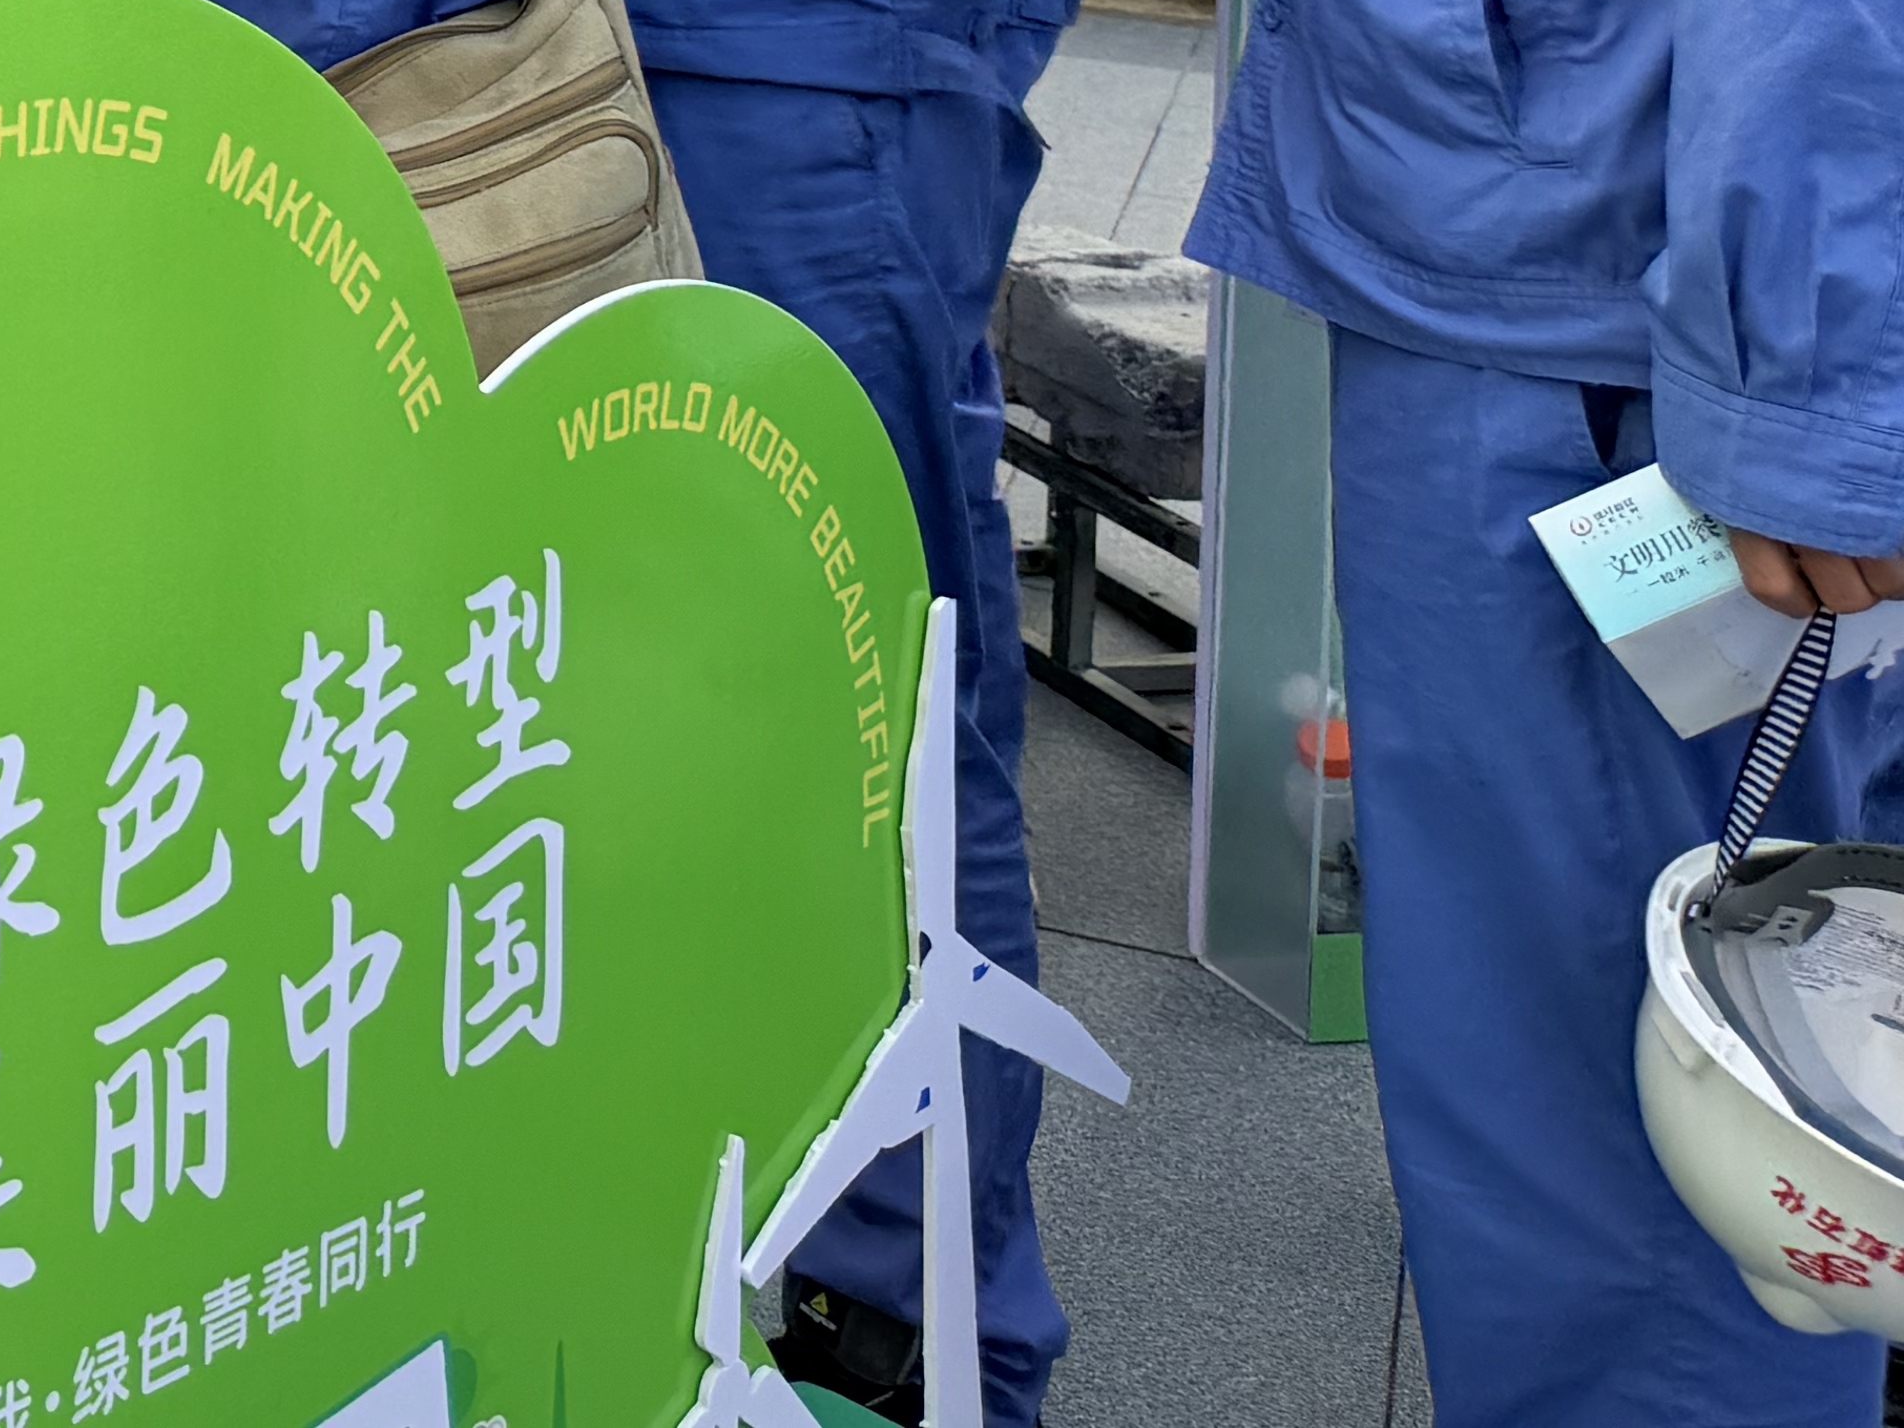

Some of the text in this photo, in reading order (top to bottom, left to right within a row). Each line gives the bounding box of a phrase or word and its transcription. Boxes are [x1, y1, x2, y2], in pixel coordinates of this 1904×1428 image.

[207, 132, 442, 436] MAKING THE
[557, 379, 890, 852] WORLD MORE BEAUTIFUL
